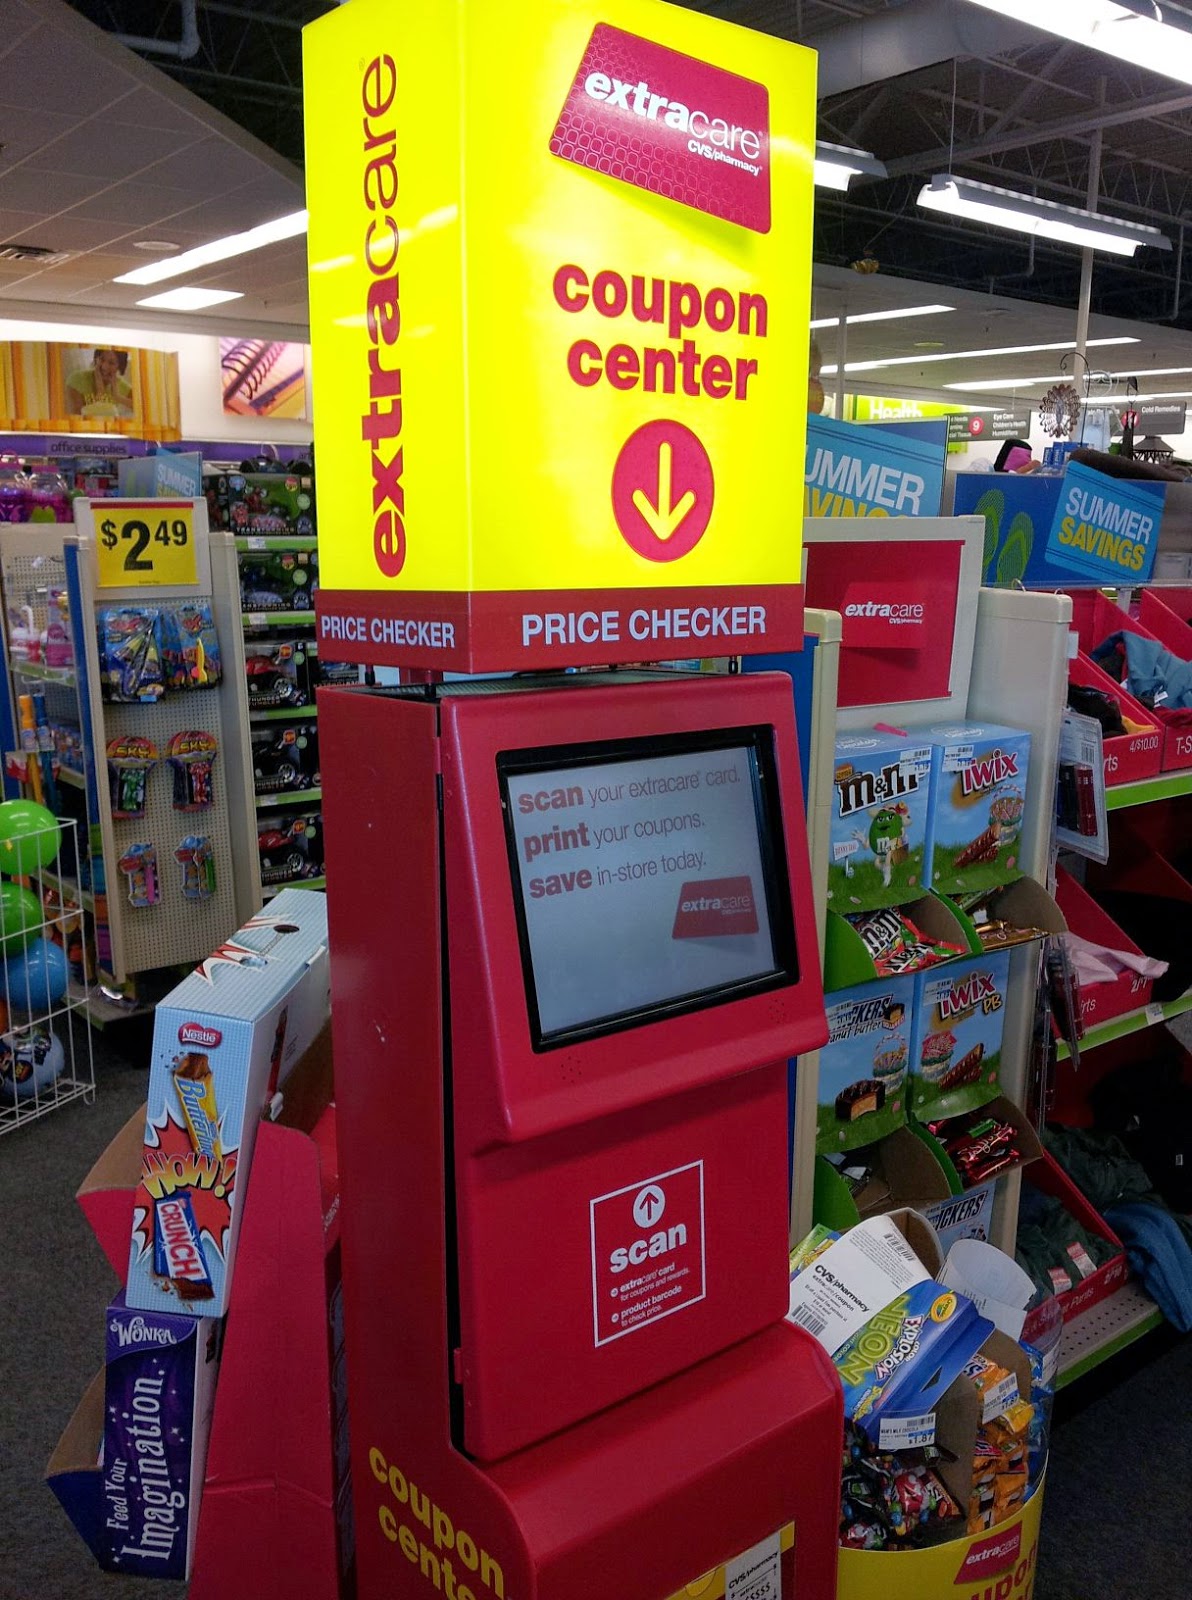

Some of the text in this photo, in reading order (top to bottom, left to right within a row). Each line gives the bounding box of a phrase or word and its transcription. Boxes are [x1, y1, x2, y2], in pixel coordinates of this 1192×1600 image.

[584, 72, 761, 160] extracare
[687, 139, 761, 177] CVS/pharmacy
[362, 53, 406, 578] extracare
[552, 263, 768, 339] coupon
[566, 338, 759, 400] center
[972, 420, 980, 431] 9
[157, 464, 196, 497] SUMMER
[805, 445, 925, 515] UMMER
[1065, 486, 1153, 545] SUMMER
[1058, 517, 1146, 571] SAVINGS
[321, 616, 456, 649] PRICE CHECKER
[521, 606, 766, 647] PRICE CHECKER
[845, 601, 924, 618] extracare
[1176, 735, 1192, 755] T-S
[518, 766, 741, 814] scan your extracare card.
[524, 812, 705, 863] print your coupons.
[529, 850, 706, 898] save in-store today.
[682, 896, 750, 912] extracare
[984, 995, 1002, 1014] PB
[853, 1021, 881, 1037] butter
[141, 1152, 237, 1199] WOW!
[160, 1202, 201, 1281] CRUNCH
[610, 1223, 687, 1274] scan
[620, 1262, 675, 1293] extracare card
[621, 1293, 629, 1301] for
[630, 1283, 655, 1299] coupons
[655, 1277, 667, 1287] and
[815, 1264, 869, 1313] CVS/pharmacy
[621, 1285, 682, 1320] product barcode
[621, 1319, 629, 1327] to
[628, 1311, 646, 1324] check
[876, 1315, 923, 1380] EXPLOSION
[909, 1433, 933, 1445] $1.87
[105, 1457, 129, 1531] Feed Your
[369, 1446, 504, 1600] coupon
[378, 1505, 477, 1600] cent
[966, 1535, 1020, 1565] extracare
